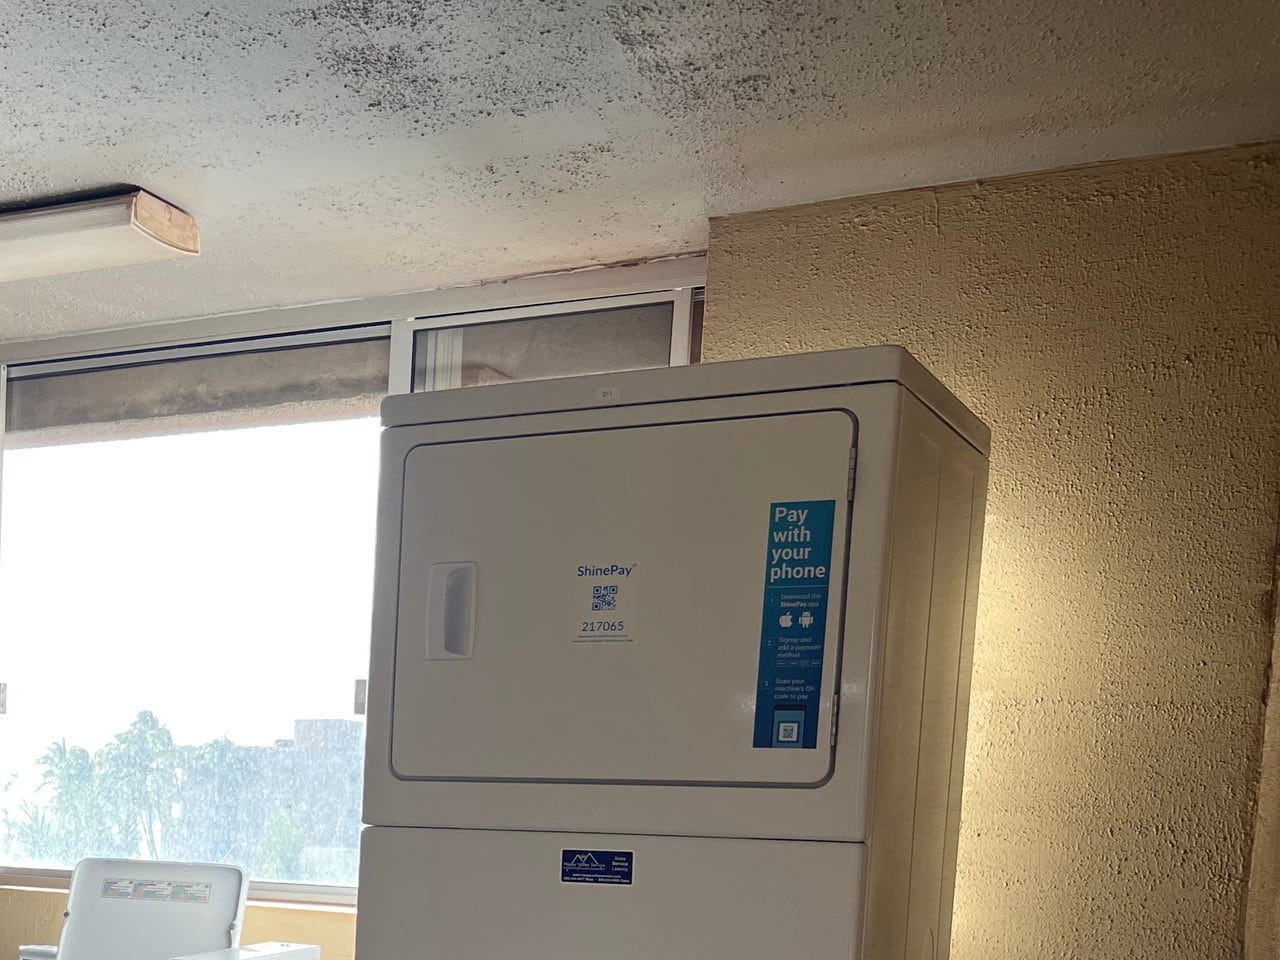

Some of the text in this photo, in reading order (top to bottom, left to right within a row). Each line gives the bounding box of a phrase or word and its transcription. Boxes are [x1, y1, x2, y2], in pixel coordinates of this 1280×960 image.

[774, 507, 808, 525] Pay
[773, 526, 811, 543] with
[771, 546, 812, 564] your
[577, 564, 632, 578] ShinePay
[770, 564, 826, 583] phone
[582, 621, 625, 632] 217065
